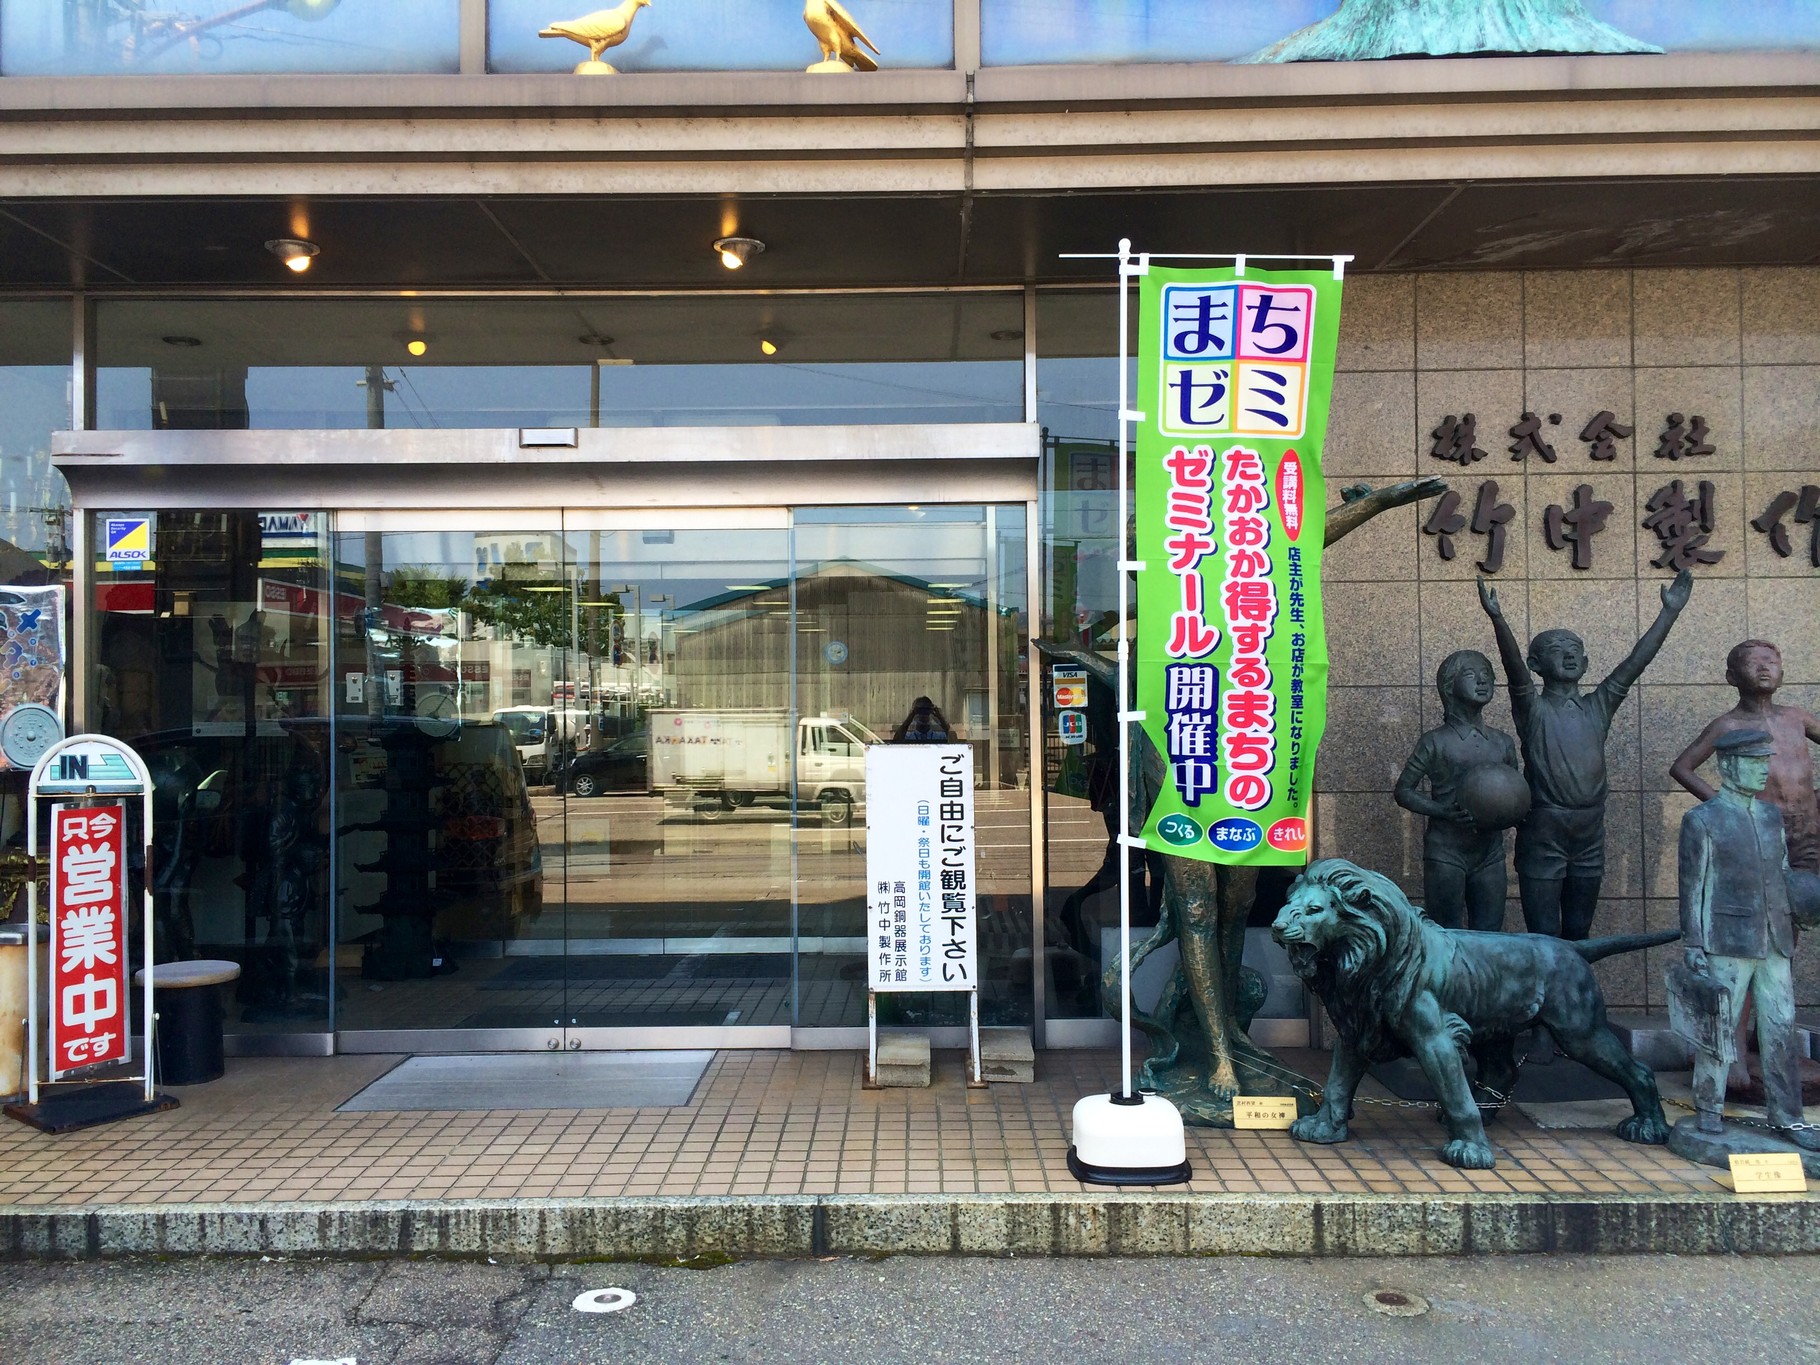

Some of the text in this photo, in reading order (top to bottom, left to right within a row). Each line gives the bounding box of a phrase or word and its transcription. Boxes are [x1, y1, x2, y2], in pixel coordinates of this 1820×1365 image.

[1172, 293, 1301, 355] まち
[1168, 368, 1289, 428] ゼミ
[1430, 409, 1717, 467] 株式会社
[109, 550, 147, 559] ALSOK
[1225, 447, 1273, 804] たかおか得するまちの
[1287, 546, 1306, 808] 店主が先生、お店が教室になりました。
[1063, 720, 1082, 728] JCB
[59, 754, 88, 781] IN
[1165, 821, 1195, 839] つくる
[1215, 827, 1256, 842] まなぶ
[917, 799, 931, 983] （日曜・祭日も開館いたしております）
[939, 753, 968, 982] ご自由にご観覧下さい
[894, 880, 907, 982] 高岡銅器展示館
